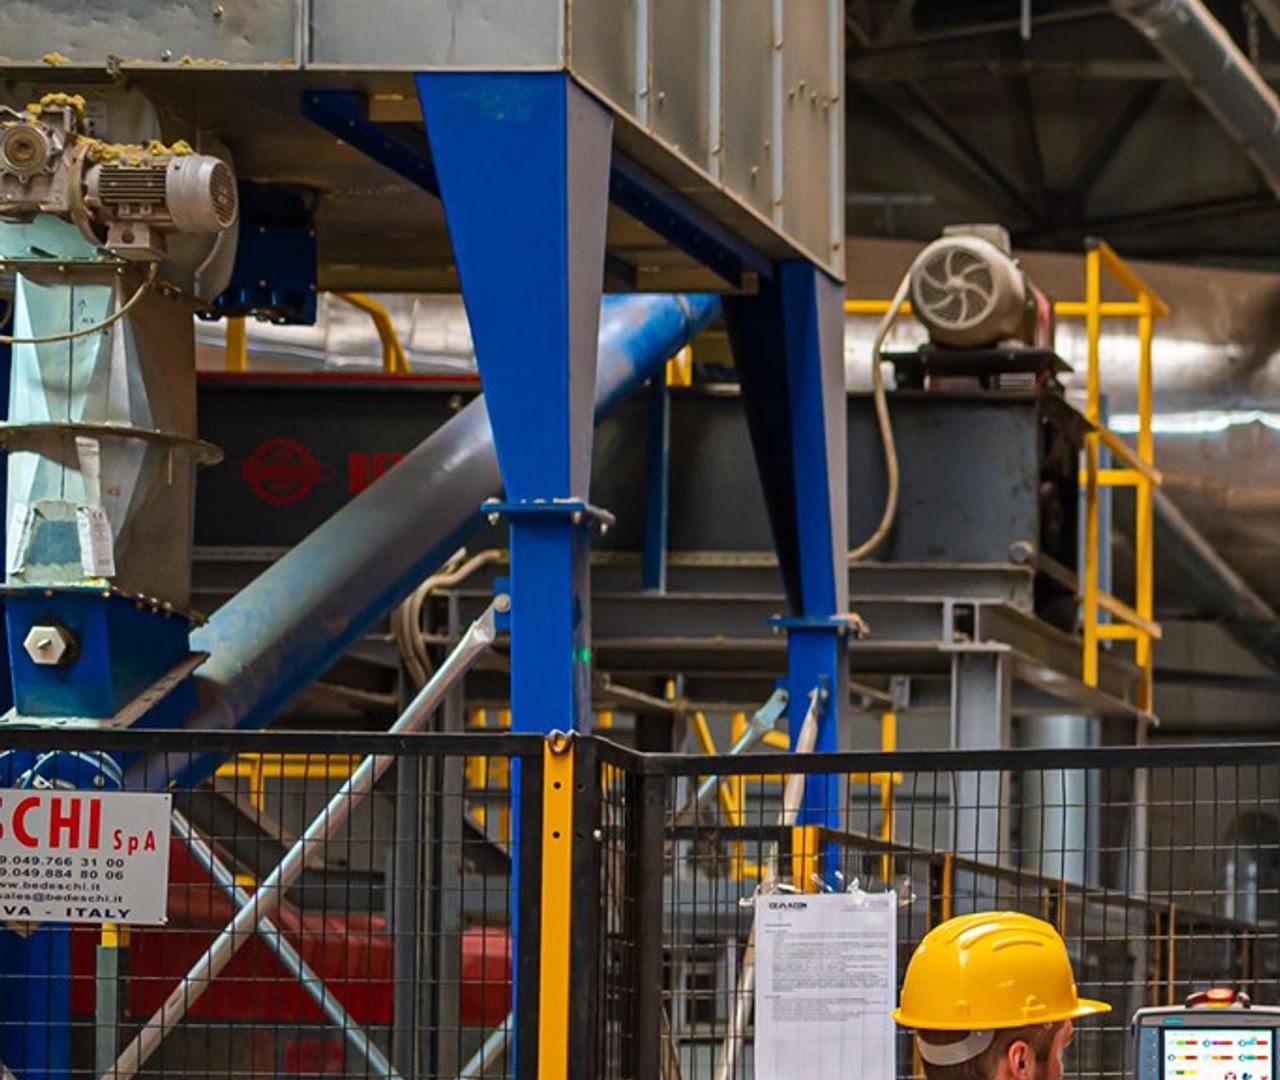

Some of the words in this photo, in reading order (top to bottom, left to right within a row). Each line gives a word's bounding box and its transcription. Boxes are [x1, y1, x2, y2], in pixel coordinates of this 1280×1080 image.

[113, 829, 156, 856] SpA
[80, 858, 97, 867] 31
[106, 859, 124, 868] 00
[80, 870, 98, 879] 80
[105, 871, 124, 880] 06
[66, 907, 131, 919] ITALY
